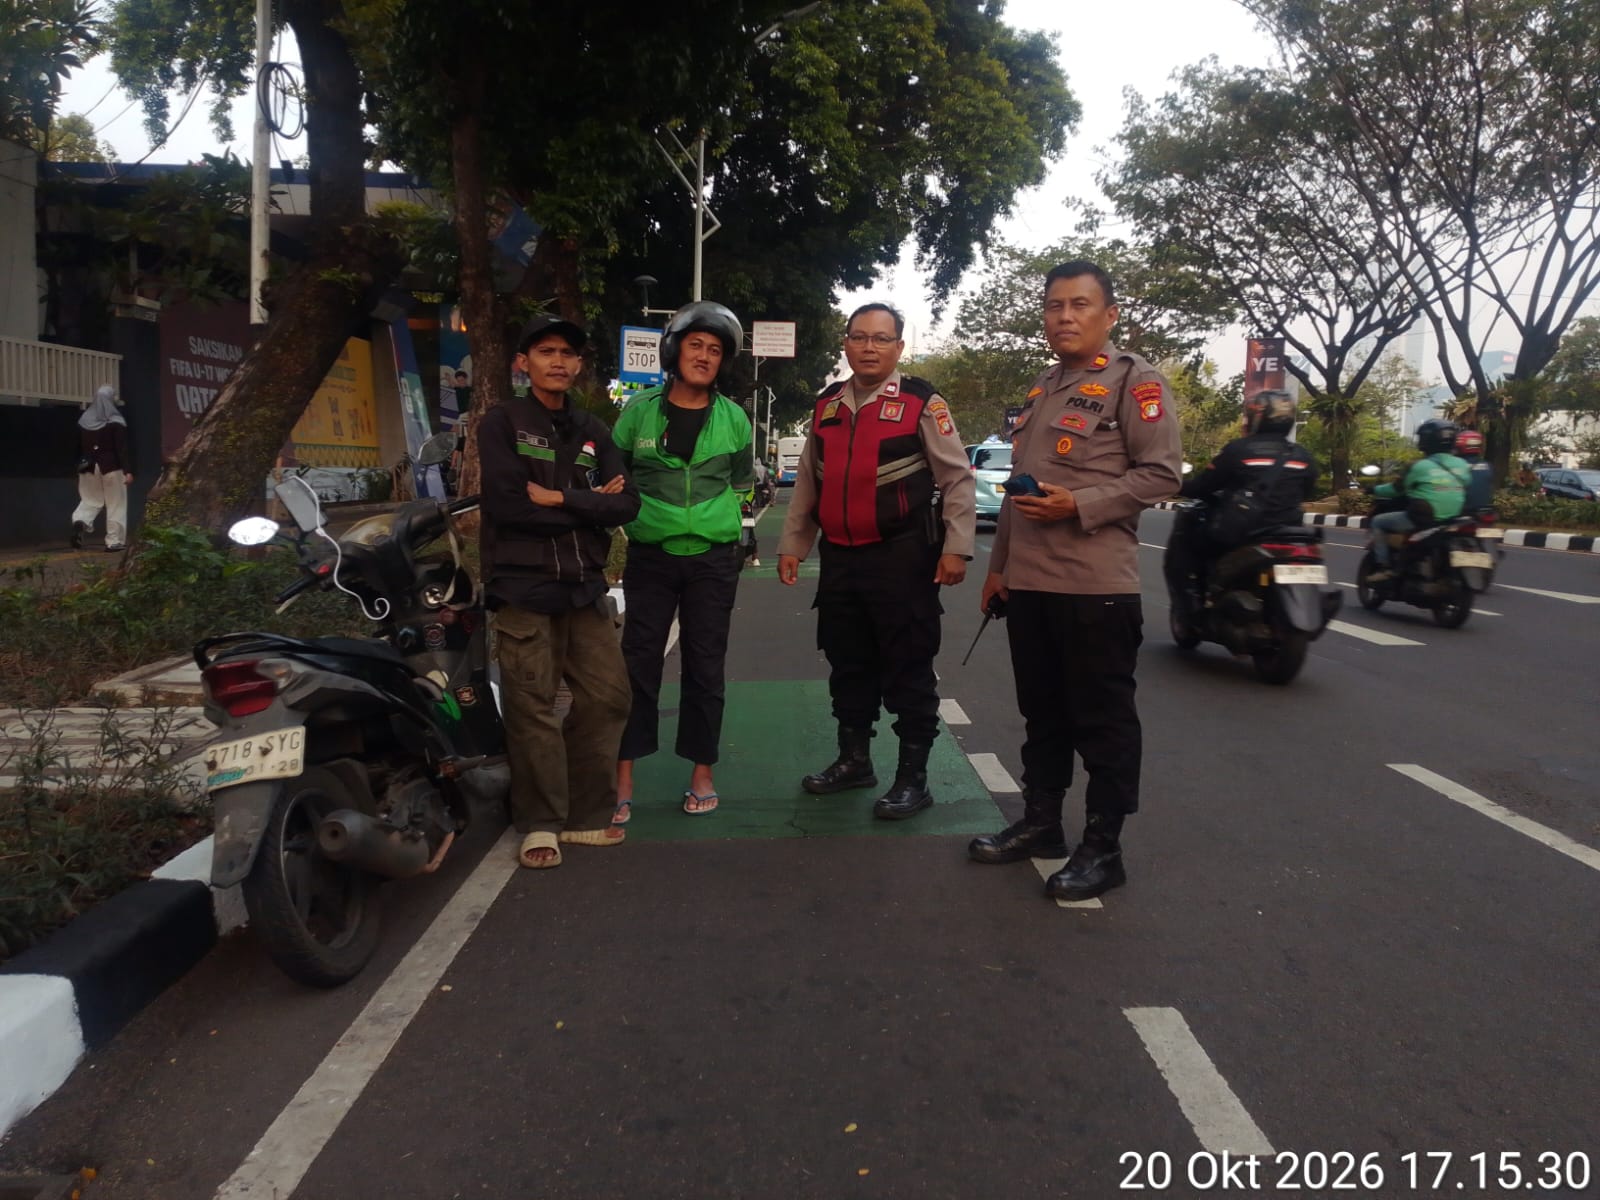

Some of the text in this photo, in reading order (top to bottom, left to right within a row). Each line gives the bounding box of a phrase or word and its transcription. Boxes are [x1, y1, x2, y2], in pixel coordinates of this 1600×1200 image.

[188, 335, 242, 362] SAKSIKAN
[169, 357, 193, 379] FIFA
[193, 361, 214, 382] U-17
[628, 352, 656, 368] STOP
[1252, 357, 1279, 372] YE
[175, 384, 218, 418] QAT
[1065, 396, 1105, 414] POLRI
[265, 731, 301, 753] SYG
